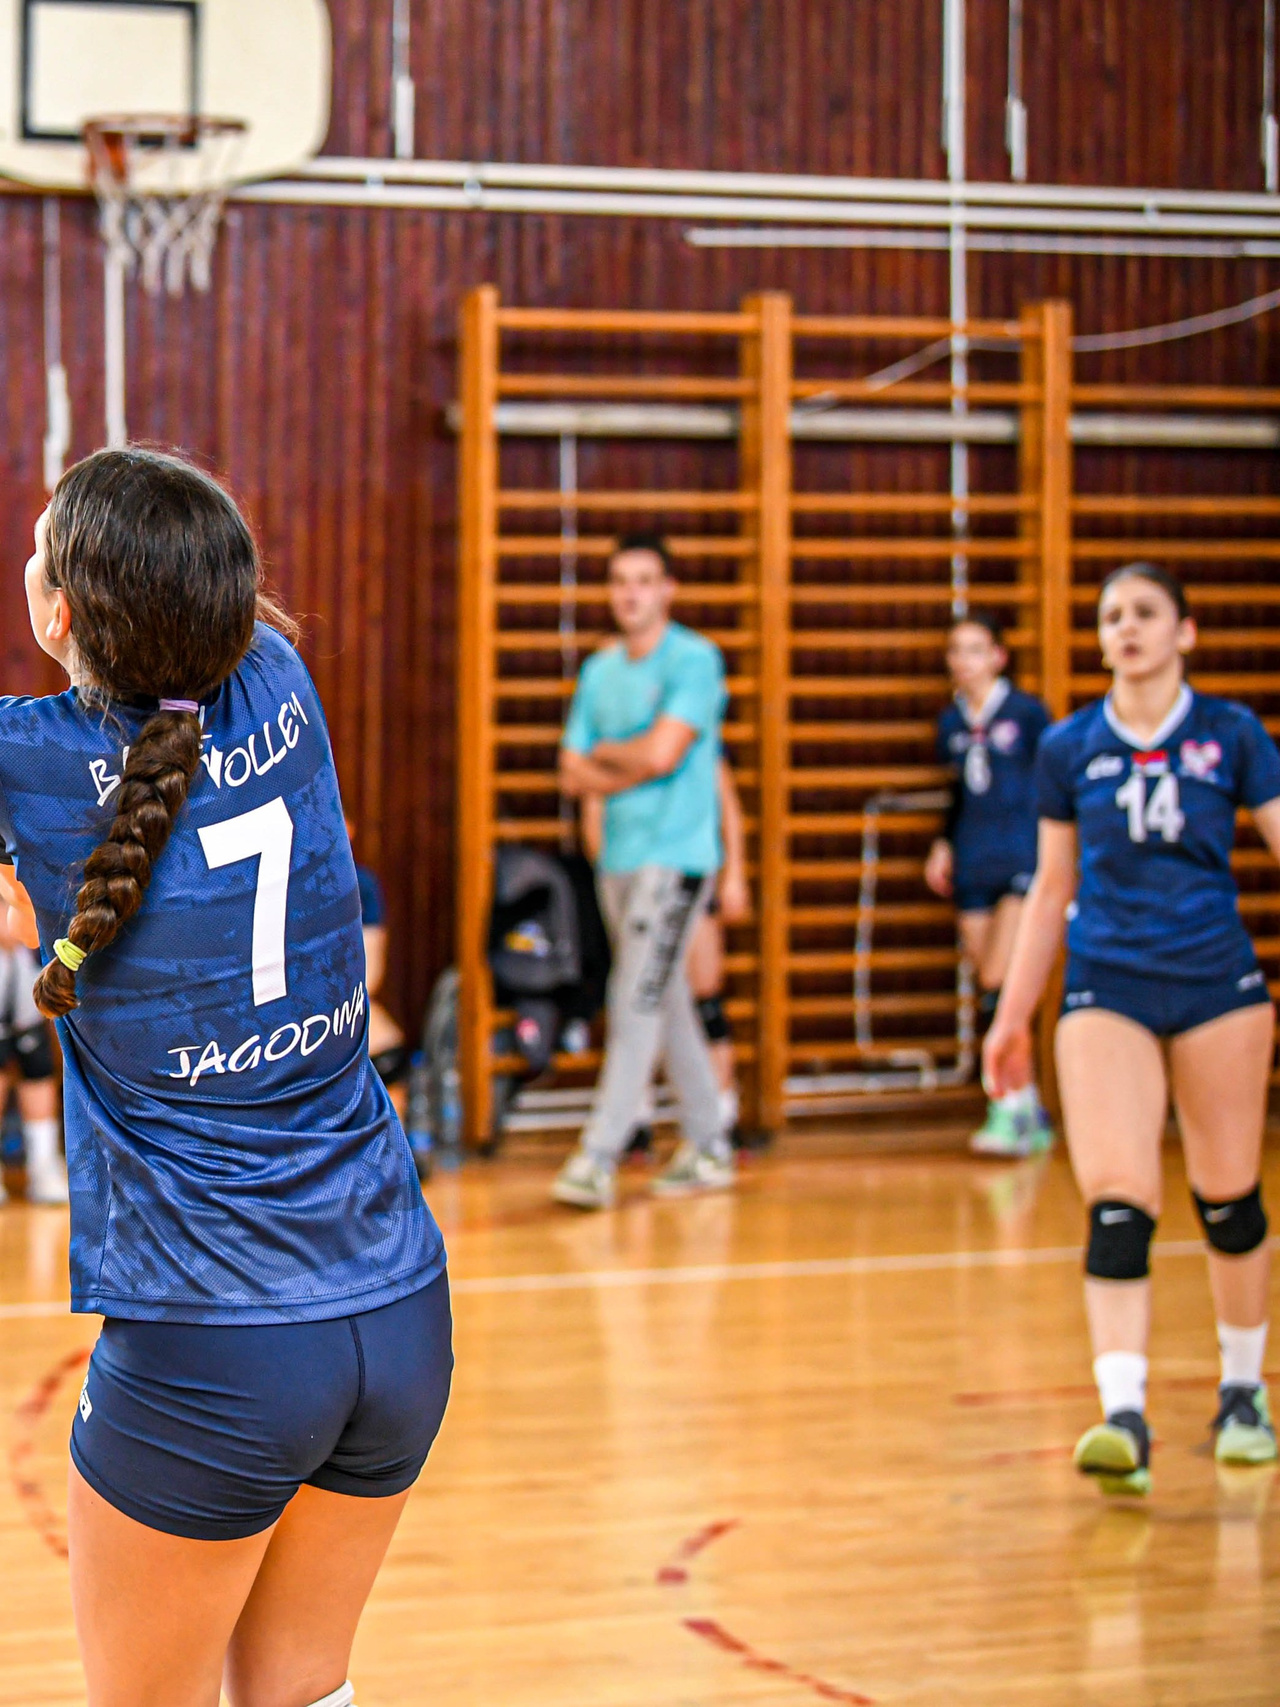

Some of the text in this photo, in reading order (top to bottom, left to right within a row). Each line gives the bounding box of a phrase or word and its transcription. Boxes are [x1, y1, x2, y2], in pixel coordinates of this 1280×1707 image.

[200, 691, 309, 789] VOLLEY
[1115, 772, 1186, 843] 14
[196, 795, 294, 1007] 7
[167, 981, 365, 1087] JAGODINA
